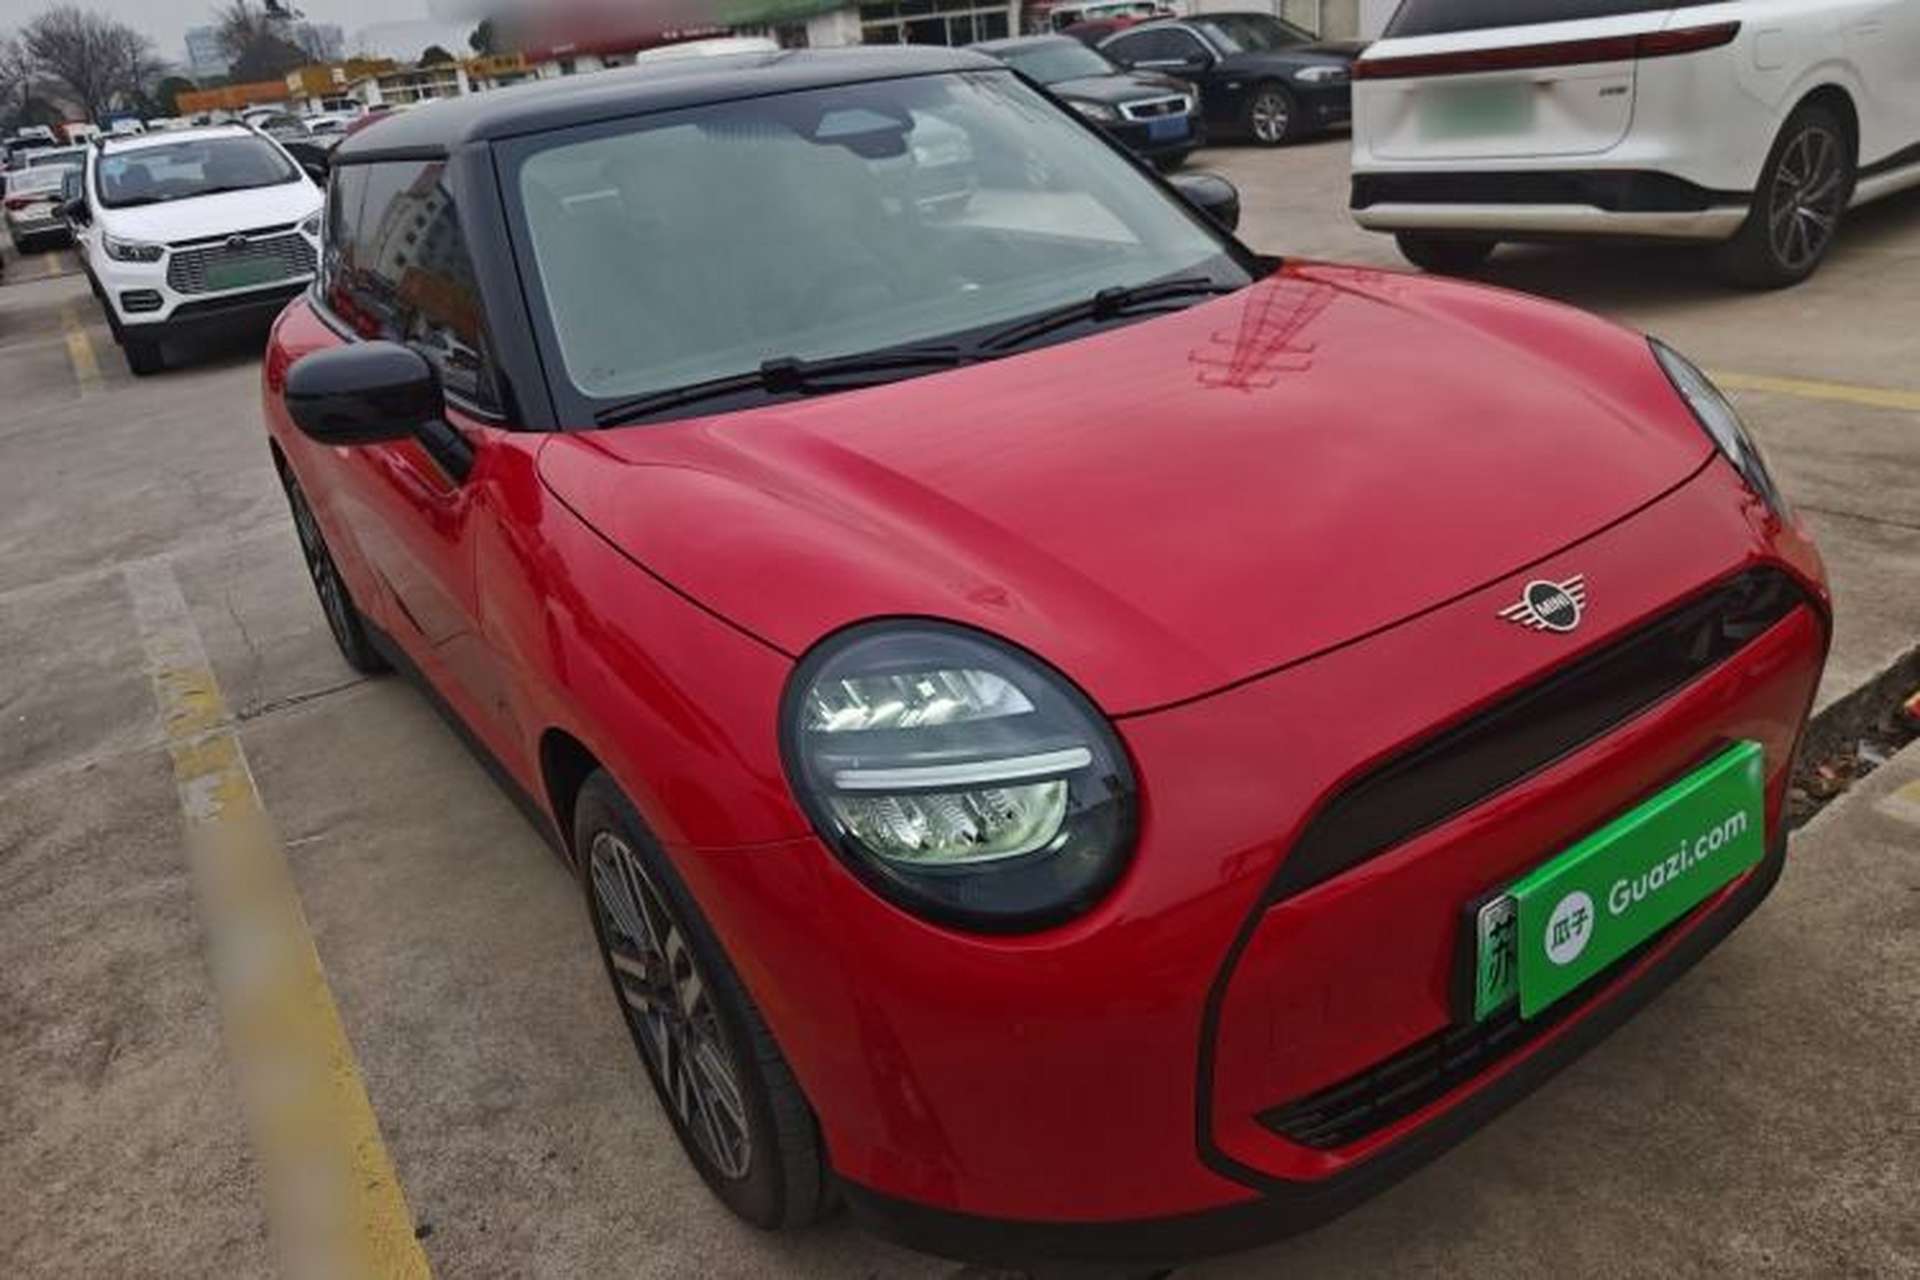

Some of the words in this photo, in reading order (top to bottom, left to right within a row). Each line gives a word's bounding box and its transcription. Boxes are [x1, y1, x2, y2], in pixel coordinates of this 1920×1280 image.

[1535, 592, 1571, 618] MINI
[1551, 906, 1589, 952] 瓜子
[1608, 810, 1747, 915] Guazi.com
